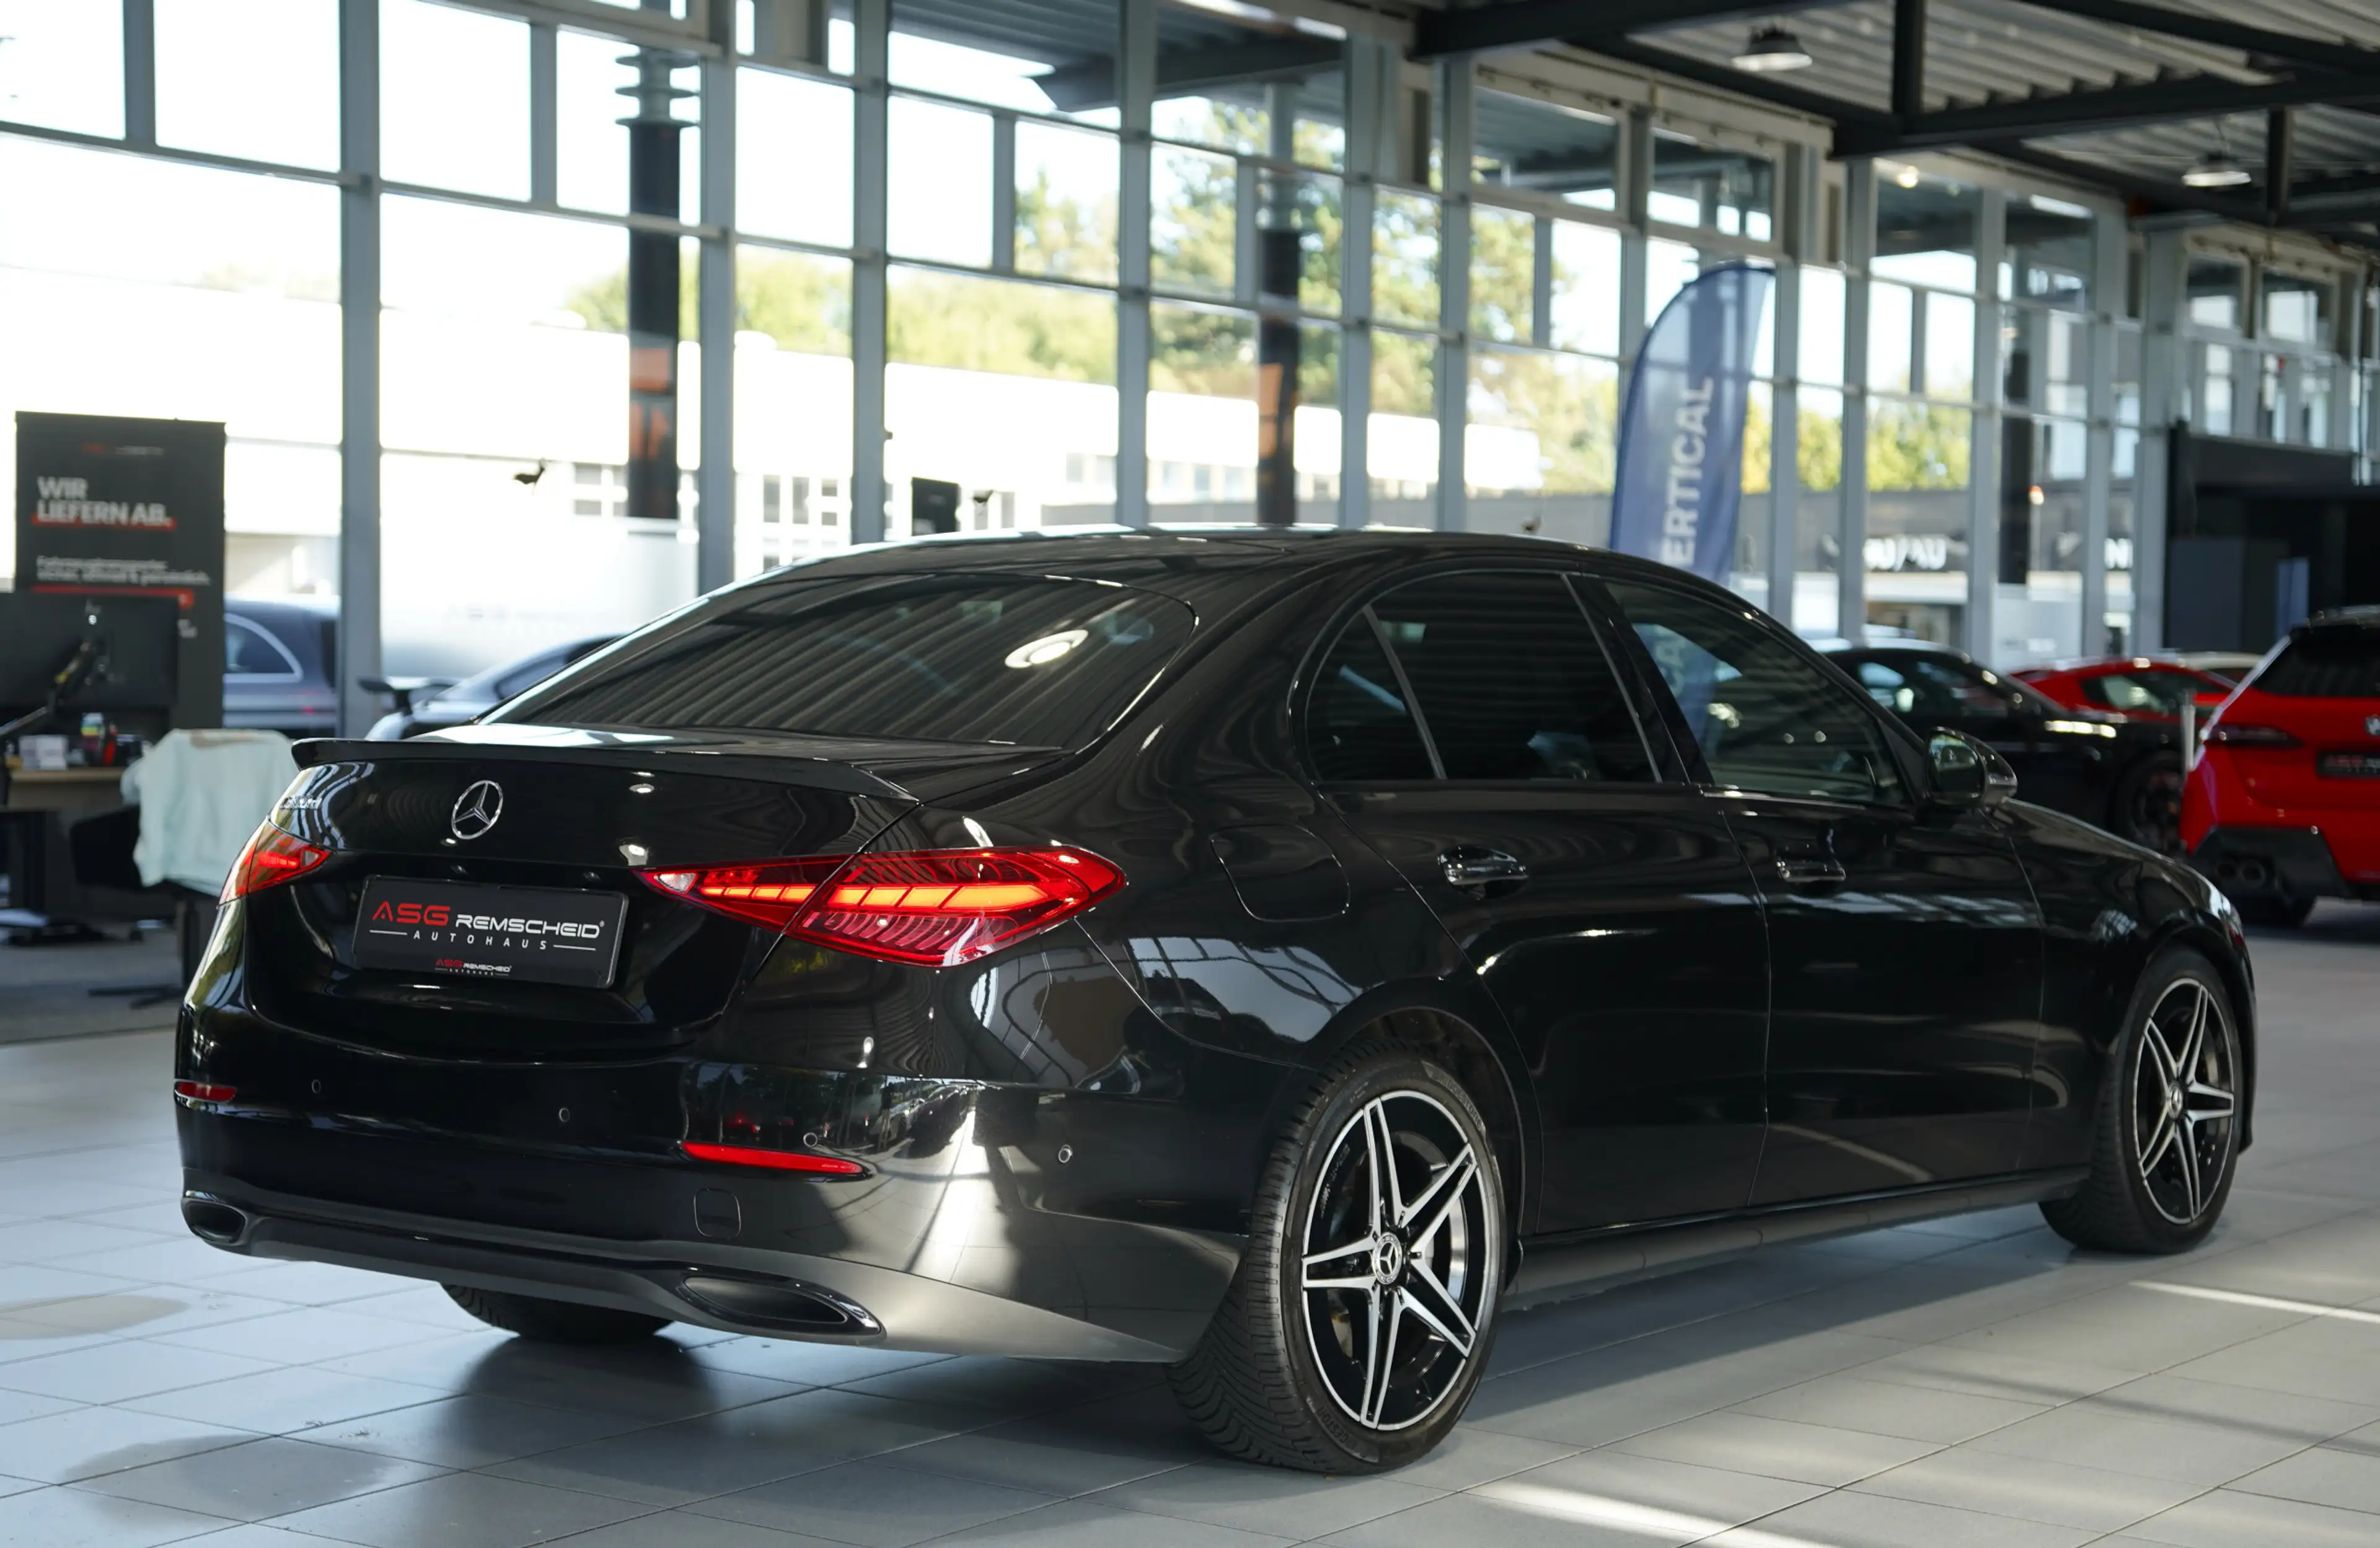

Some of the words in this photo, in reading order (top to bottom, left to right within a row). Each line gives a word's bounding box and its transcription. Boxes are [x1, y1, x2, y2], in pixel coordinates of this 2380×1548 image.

[1660, 374, 1714, 568] ERTICAL
[37, 477, 88, 500] WIR
[37, 499, 128, 526] LIEFERN
[372, 900, 451, 926] ASG
[413, 932, 547, 951] AUTOHAUS
[435, 958, 463, 969] ASG
